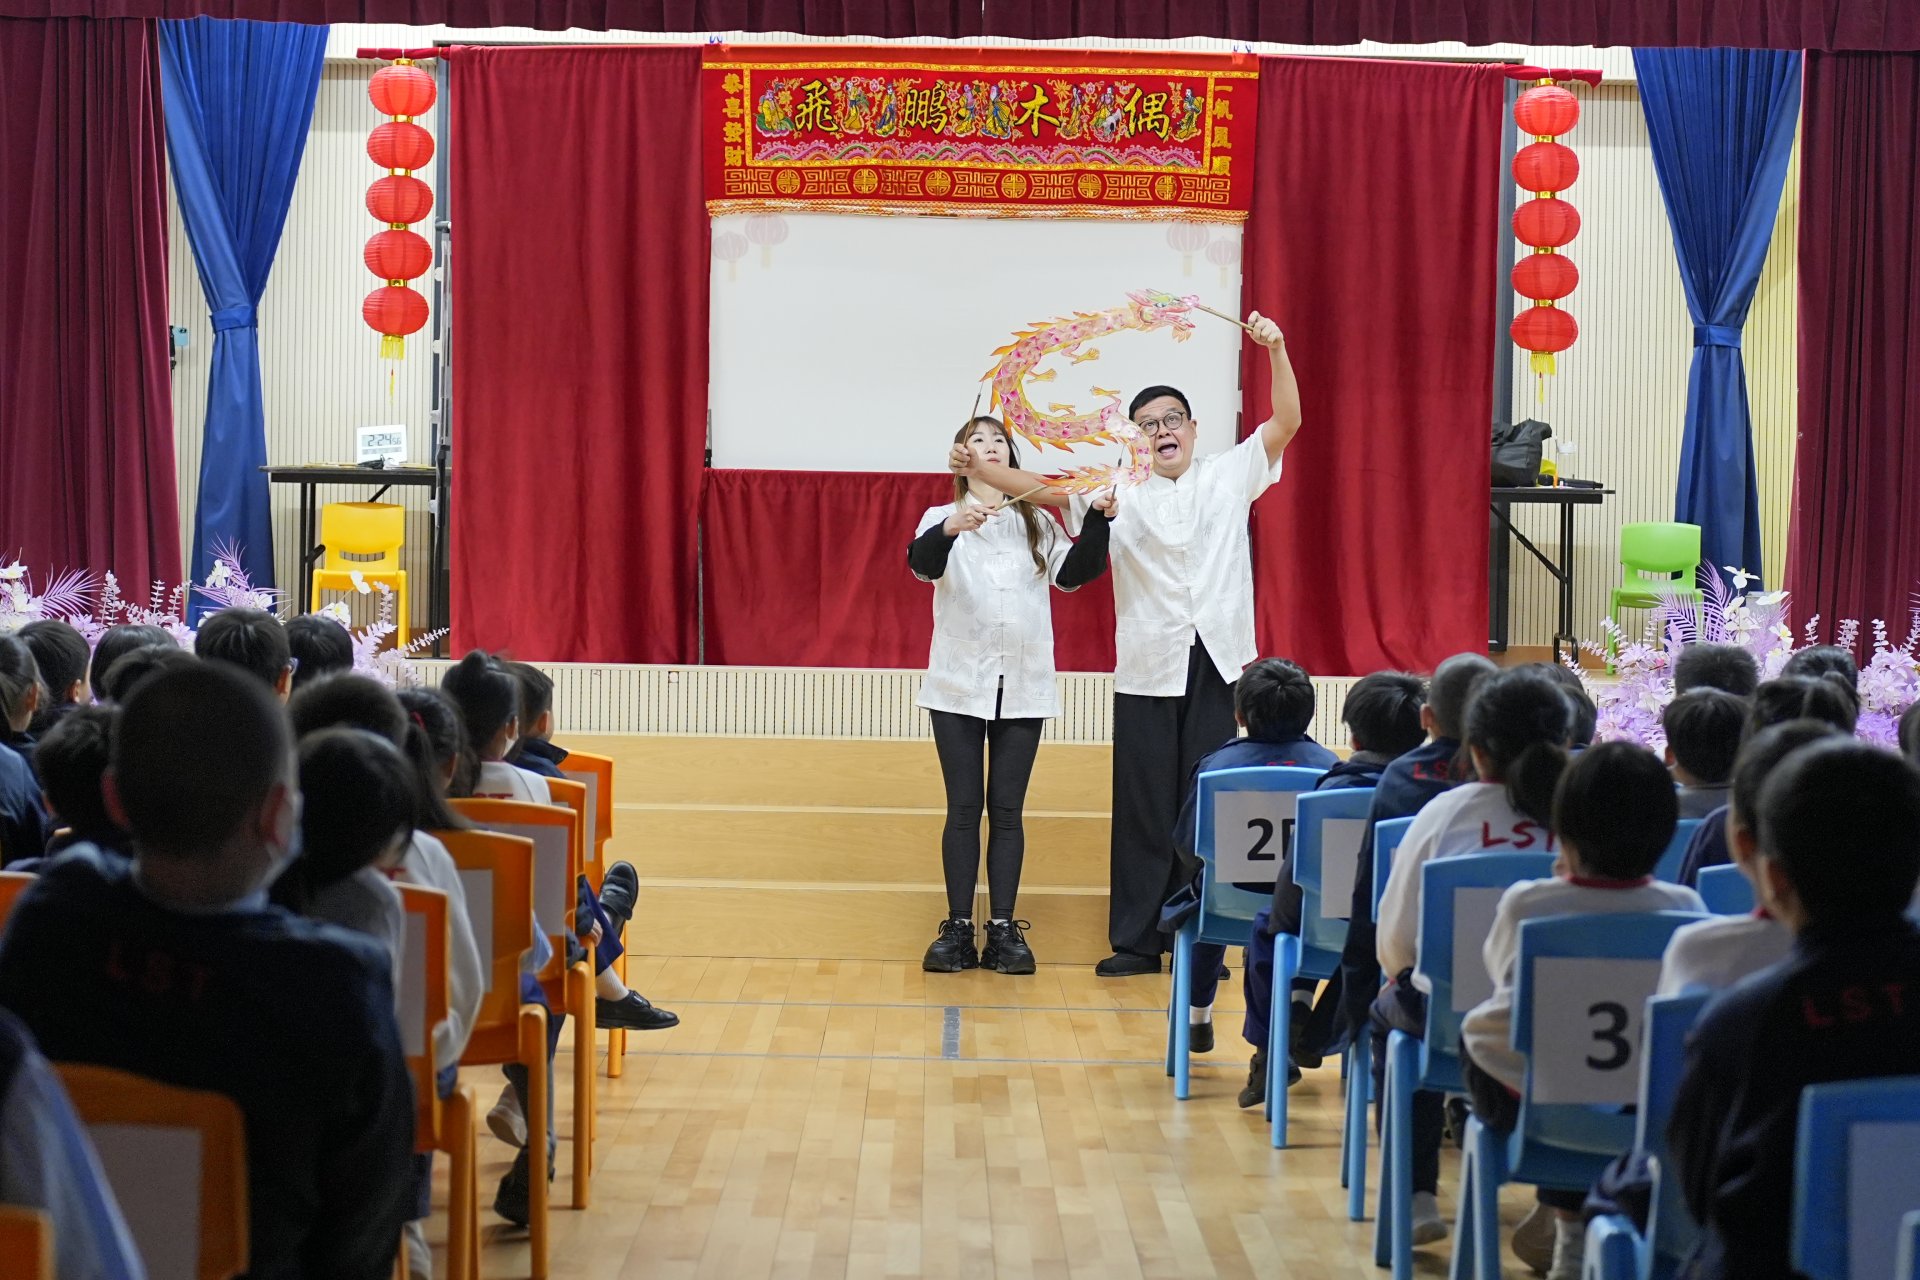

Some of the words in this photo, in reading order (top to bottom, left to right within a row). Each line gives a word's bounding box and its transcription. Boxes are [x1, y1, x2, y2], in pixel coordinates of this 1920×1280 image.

[797, 79, 1169, 138] 飛鵬木偶
[1801, 984, 1904, 1027] LST
